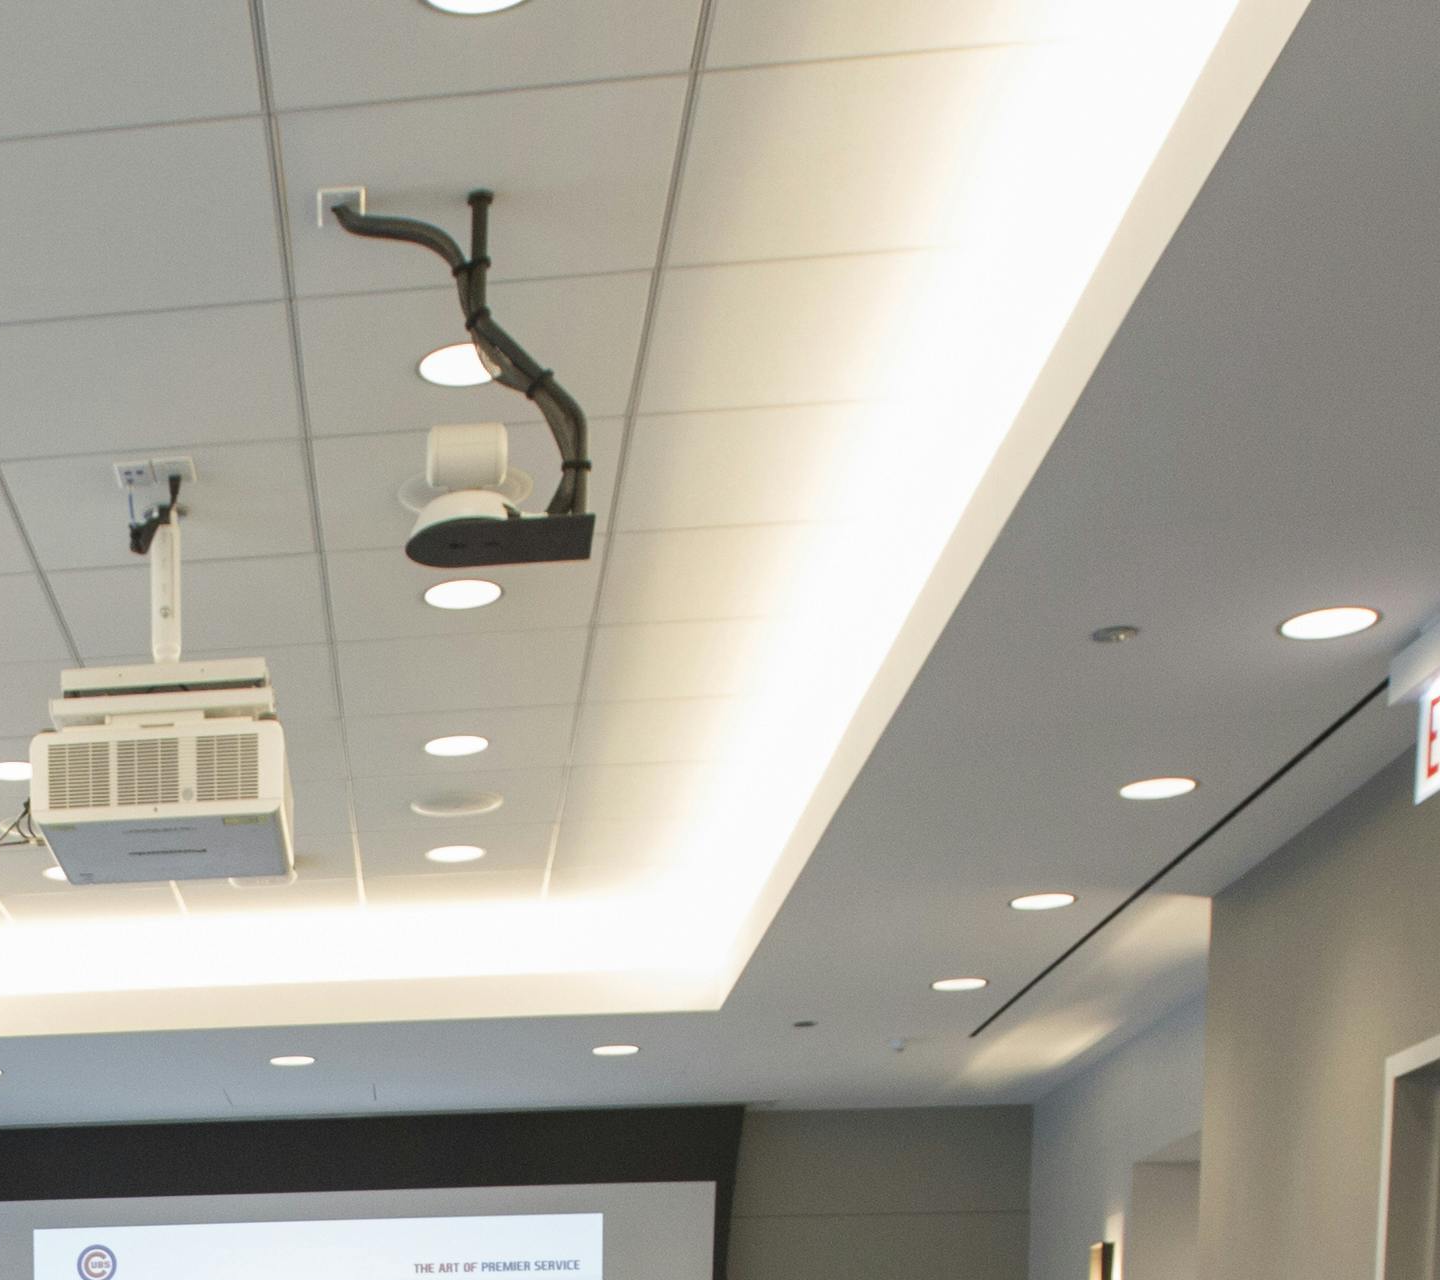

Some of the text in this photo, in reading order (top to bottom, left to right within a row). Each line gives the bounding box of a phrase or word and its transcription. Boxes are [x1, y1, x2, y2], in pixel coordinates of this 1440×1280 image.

[414, 1259, 581, 1274] THE ART OF PREMIER SERVICE
